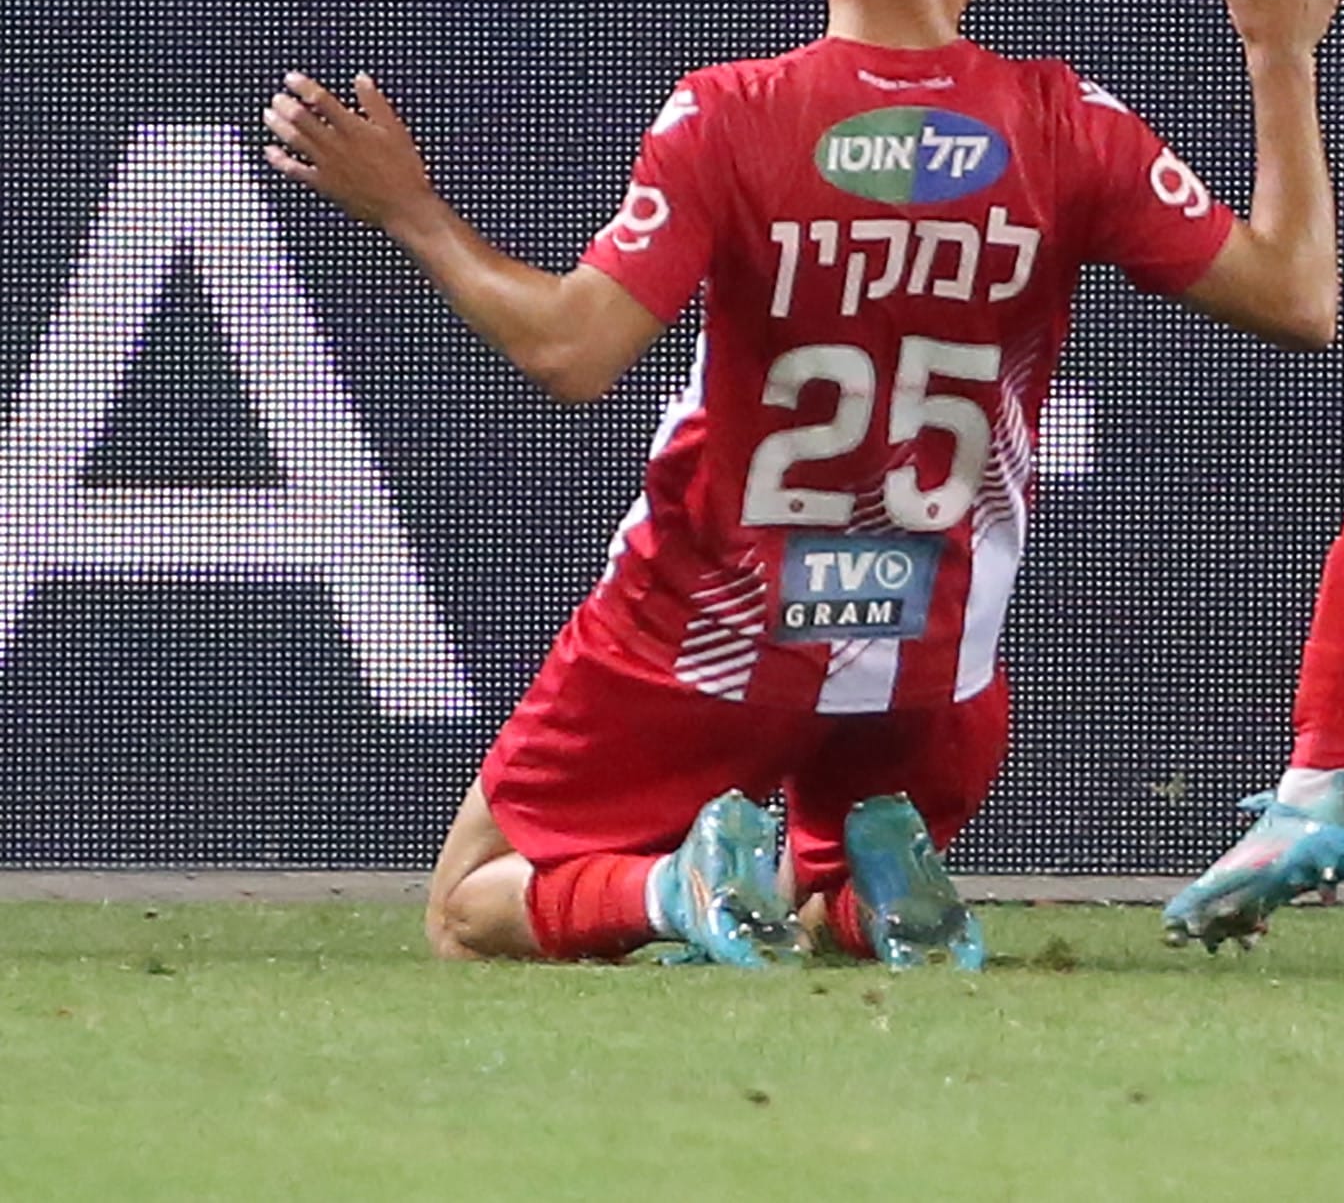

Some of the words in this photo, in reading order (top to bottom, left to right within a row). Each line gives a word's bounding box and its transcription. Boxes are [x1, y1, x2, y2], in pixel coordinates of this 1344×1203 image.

[825, 134, 915, 172] אוטו
[921, 127, 990, 179] קל
[770, 207, 1042, 318] למקין
[740, 335, 1002, 533] 25
[785, 601, 893, 628] GRAM
